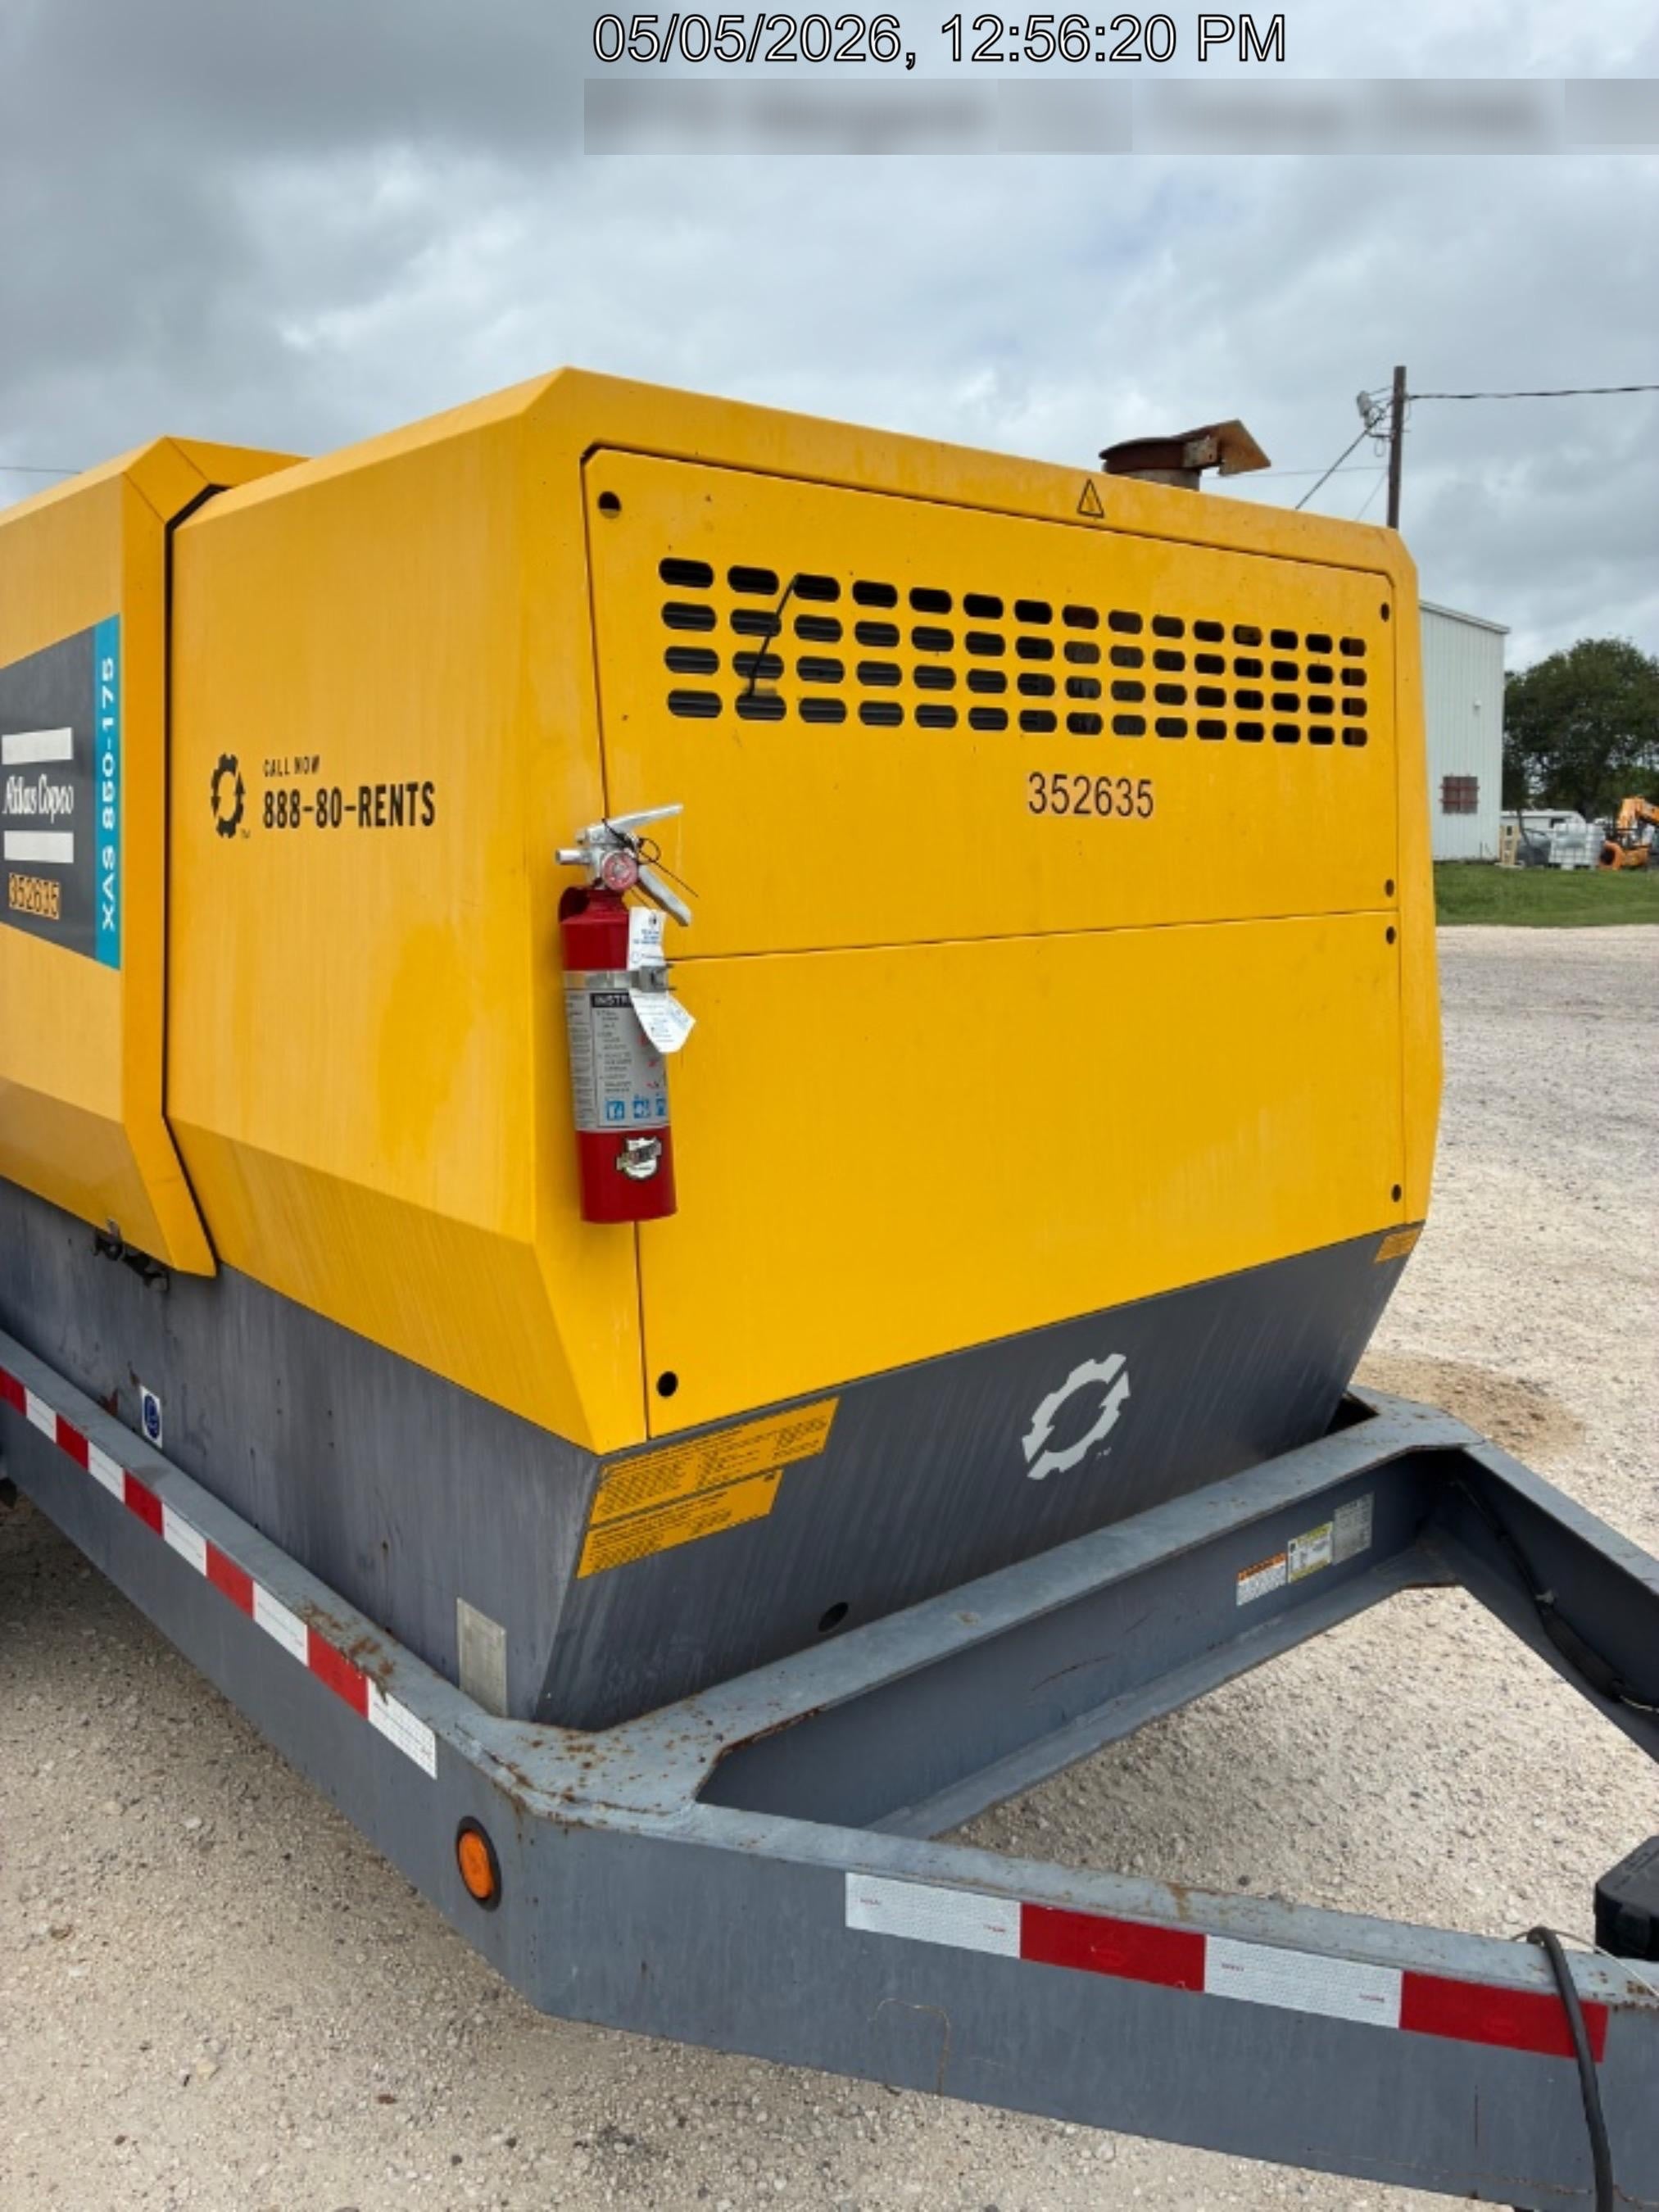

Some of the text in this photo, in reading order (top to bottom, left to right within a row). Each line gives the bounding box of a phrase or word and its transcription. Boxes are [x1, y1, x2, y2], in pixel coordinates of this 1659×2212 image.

[263, 755, 320, 777] CALL NOW
[2, 773, 75, 824] Atlas Copco
[263, 781, 436, 829] 888-80-RENTS
[1028, 772, 1154, 818] 352635
[102, 845, 116, 931] XAS
